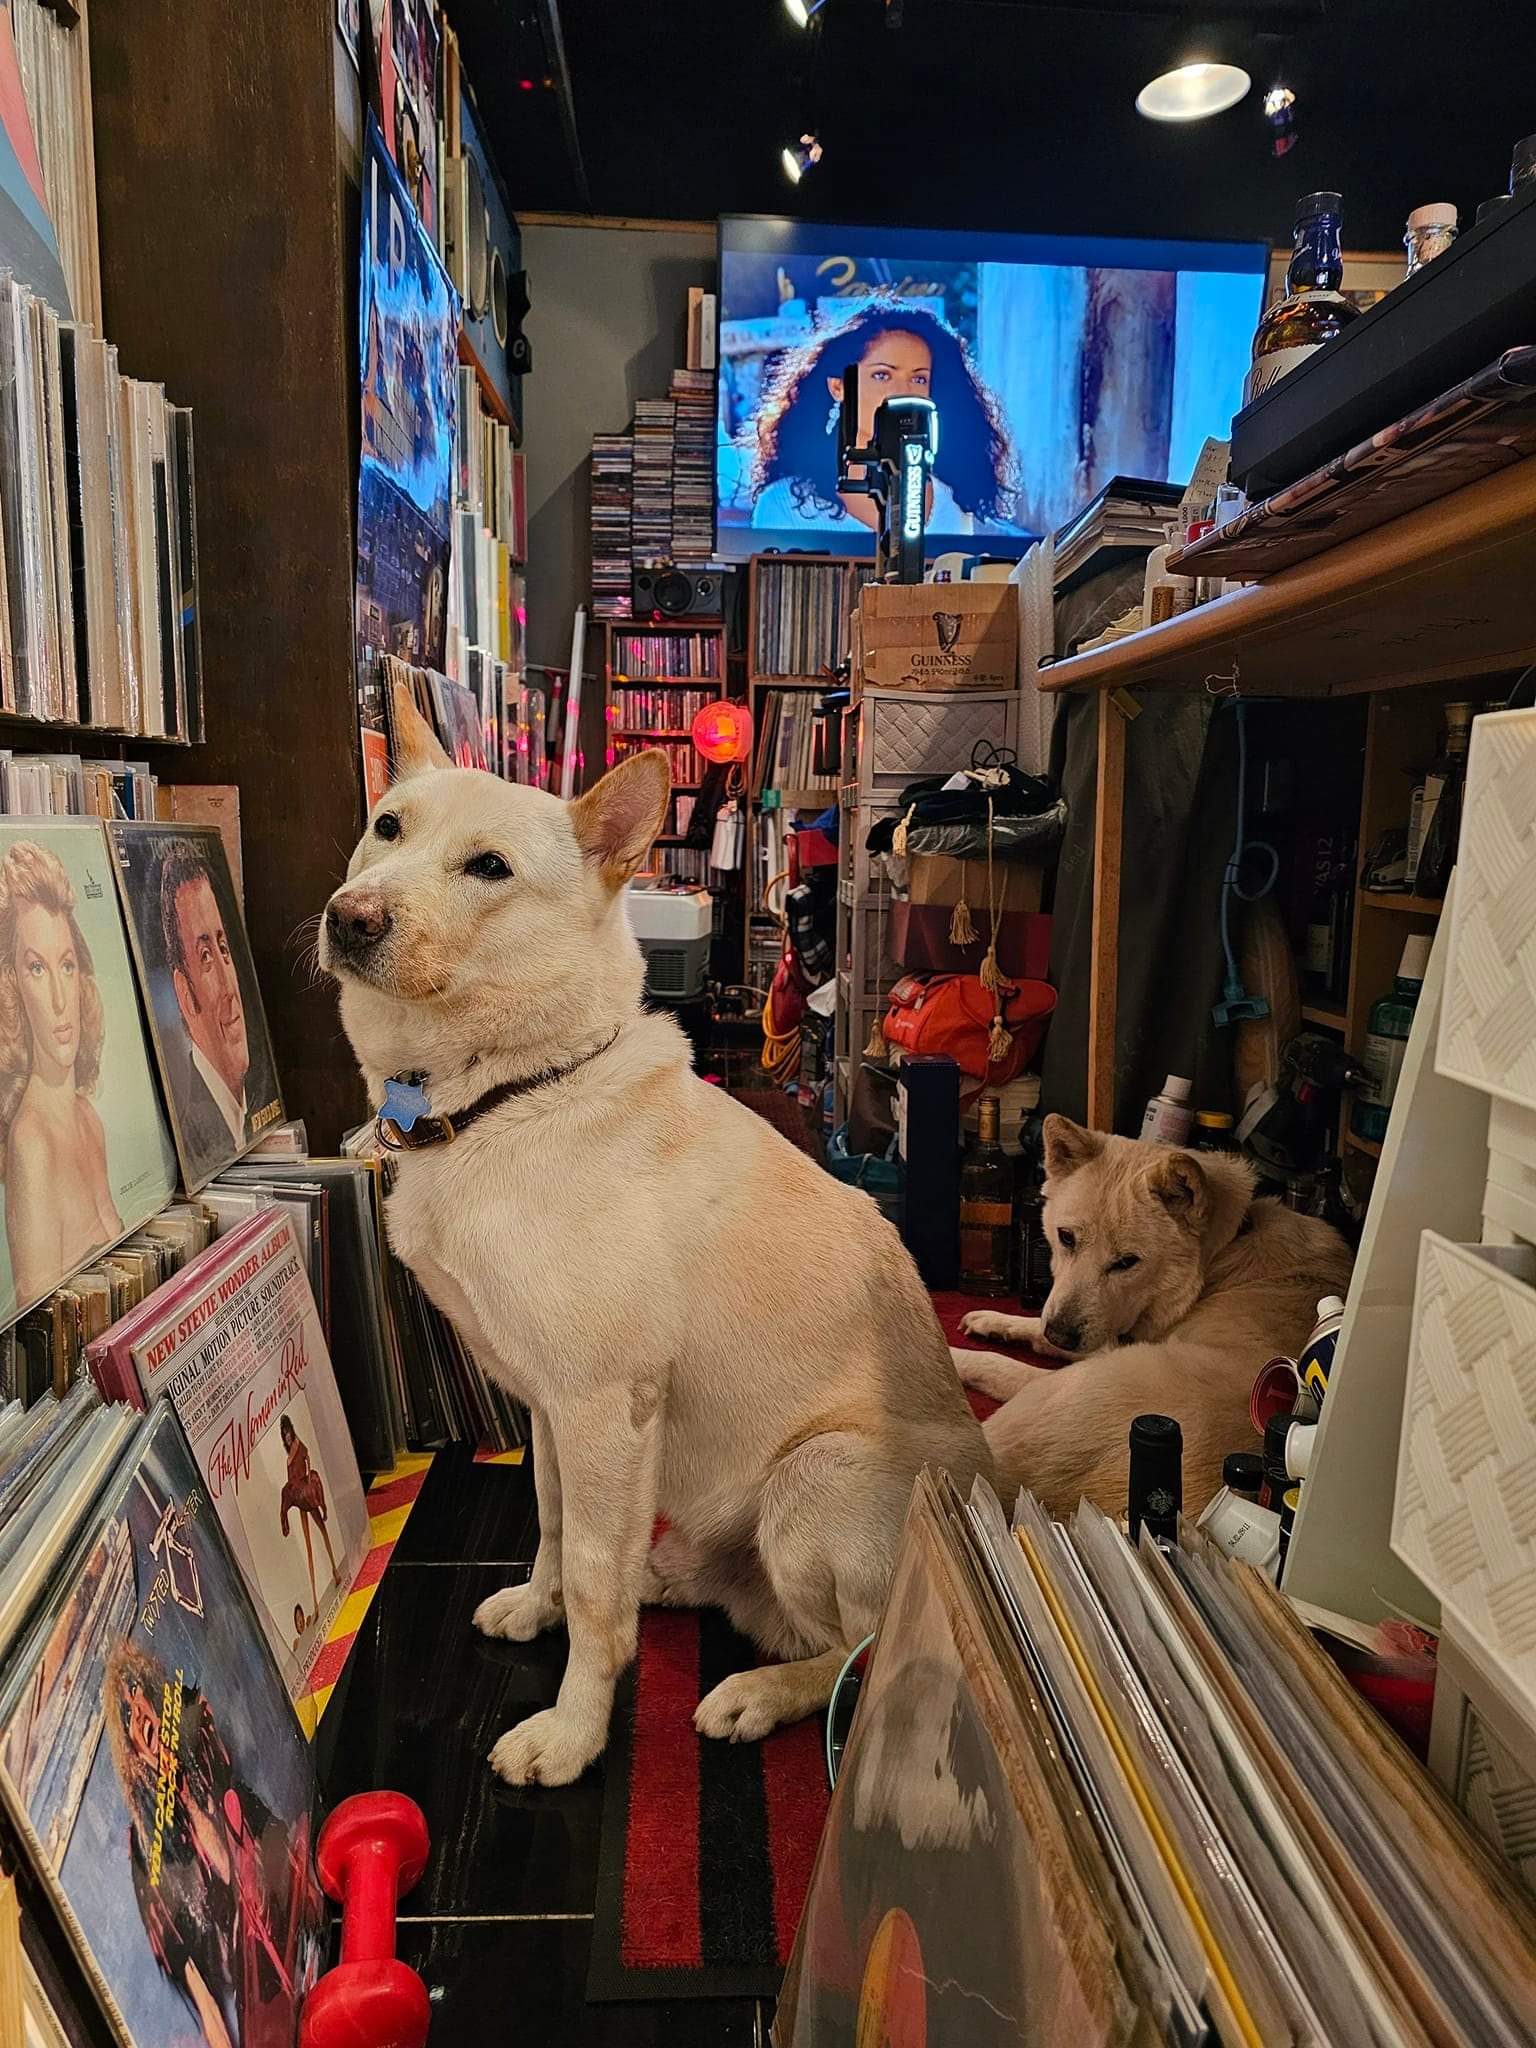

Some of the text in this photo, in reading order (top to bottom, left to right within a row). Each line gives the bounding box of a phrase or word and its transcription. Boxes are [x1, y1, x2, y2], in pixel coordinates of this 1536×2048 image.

[904, 468, 923, 539] GUINNESS
[911, 653, 972, 667] GUINNESS
[145, 1329, 177, 1374] NEW
[178, 1292, 218, 1345] STEVIE
[217, 1254, 260, 1304] WONDER
[260, 1225, 290, 1267] ALBUM
[167, 1355, 200, 1401] IGINAL
[200, 1323, 230, 1368] MOTION
[230, 1292, 260, 1337] PICTURE
[260, 1252, 298, 1307] SOUNDTRACK
[276, 1377, 289, 1400] in
[281, 1322, 310, 1401] Red
[230, 1391, 279, 1496] Woman
[140, 1568, 170, 1637] TWISTED
[150, 1829, 163, 1887] YOU
[161, 1681, 172, 1747] STOP
[165, 1752, 178, 1828] ROCK
[172, 1668, 184, 1723] ROLL
